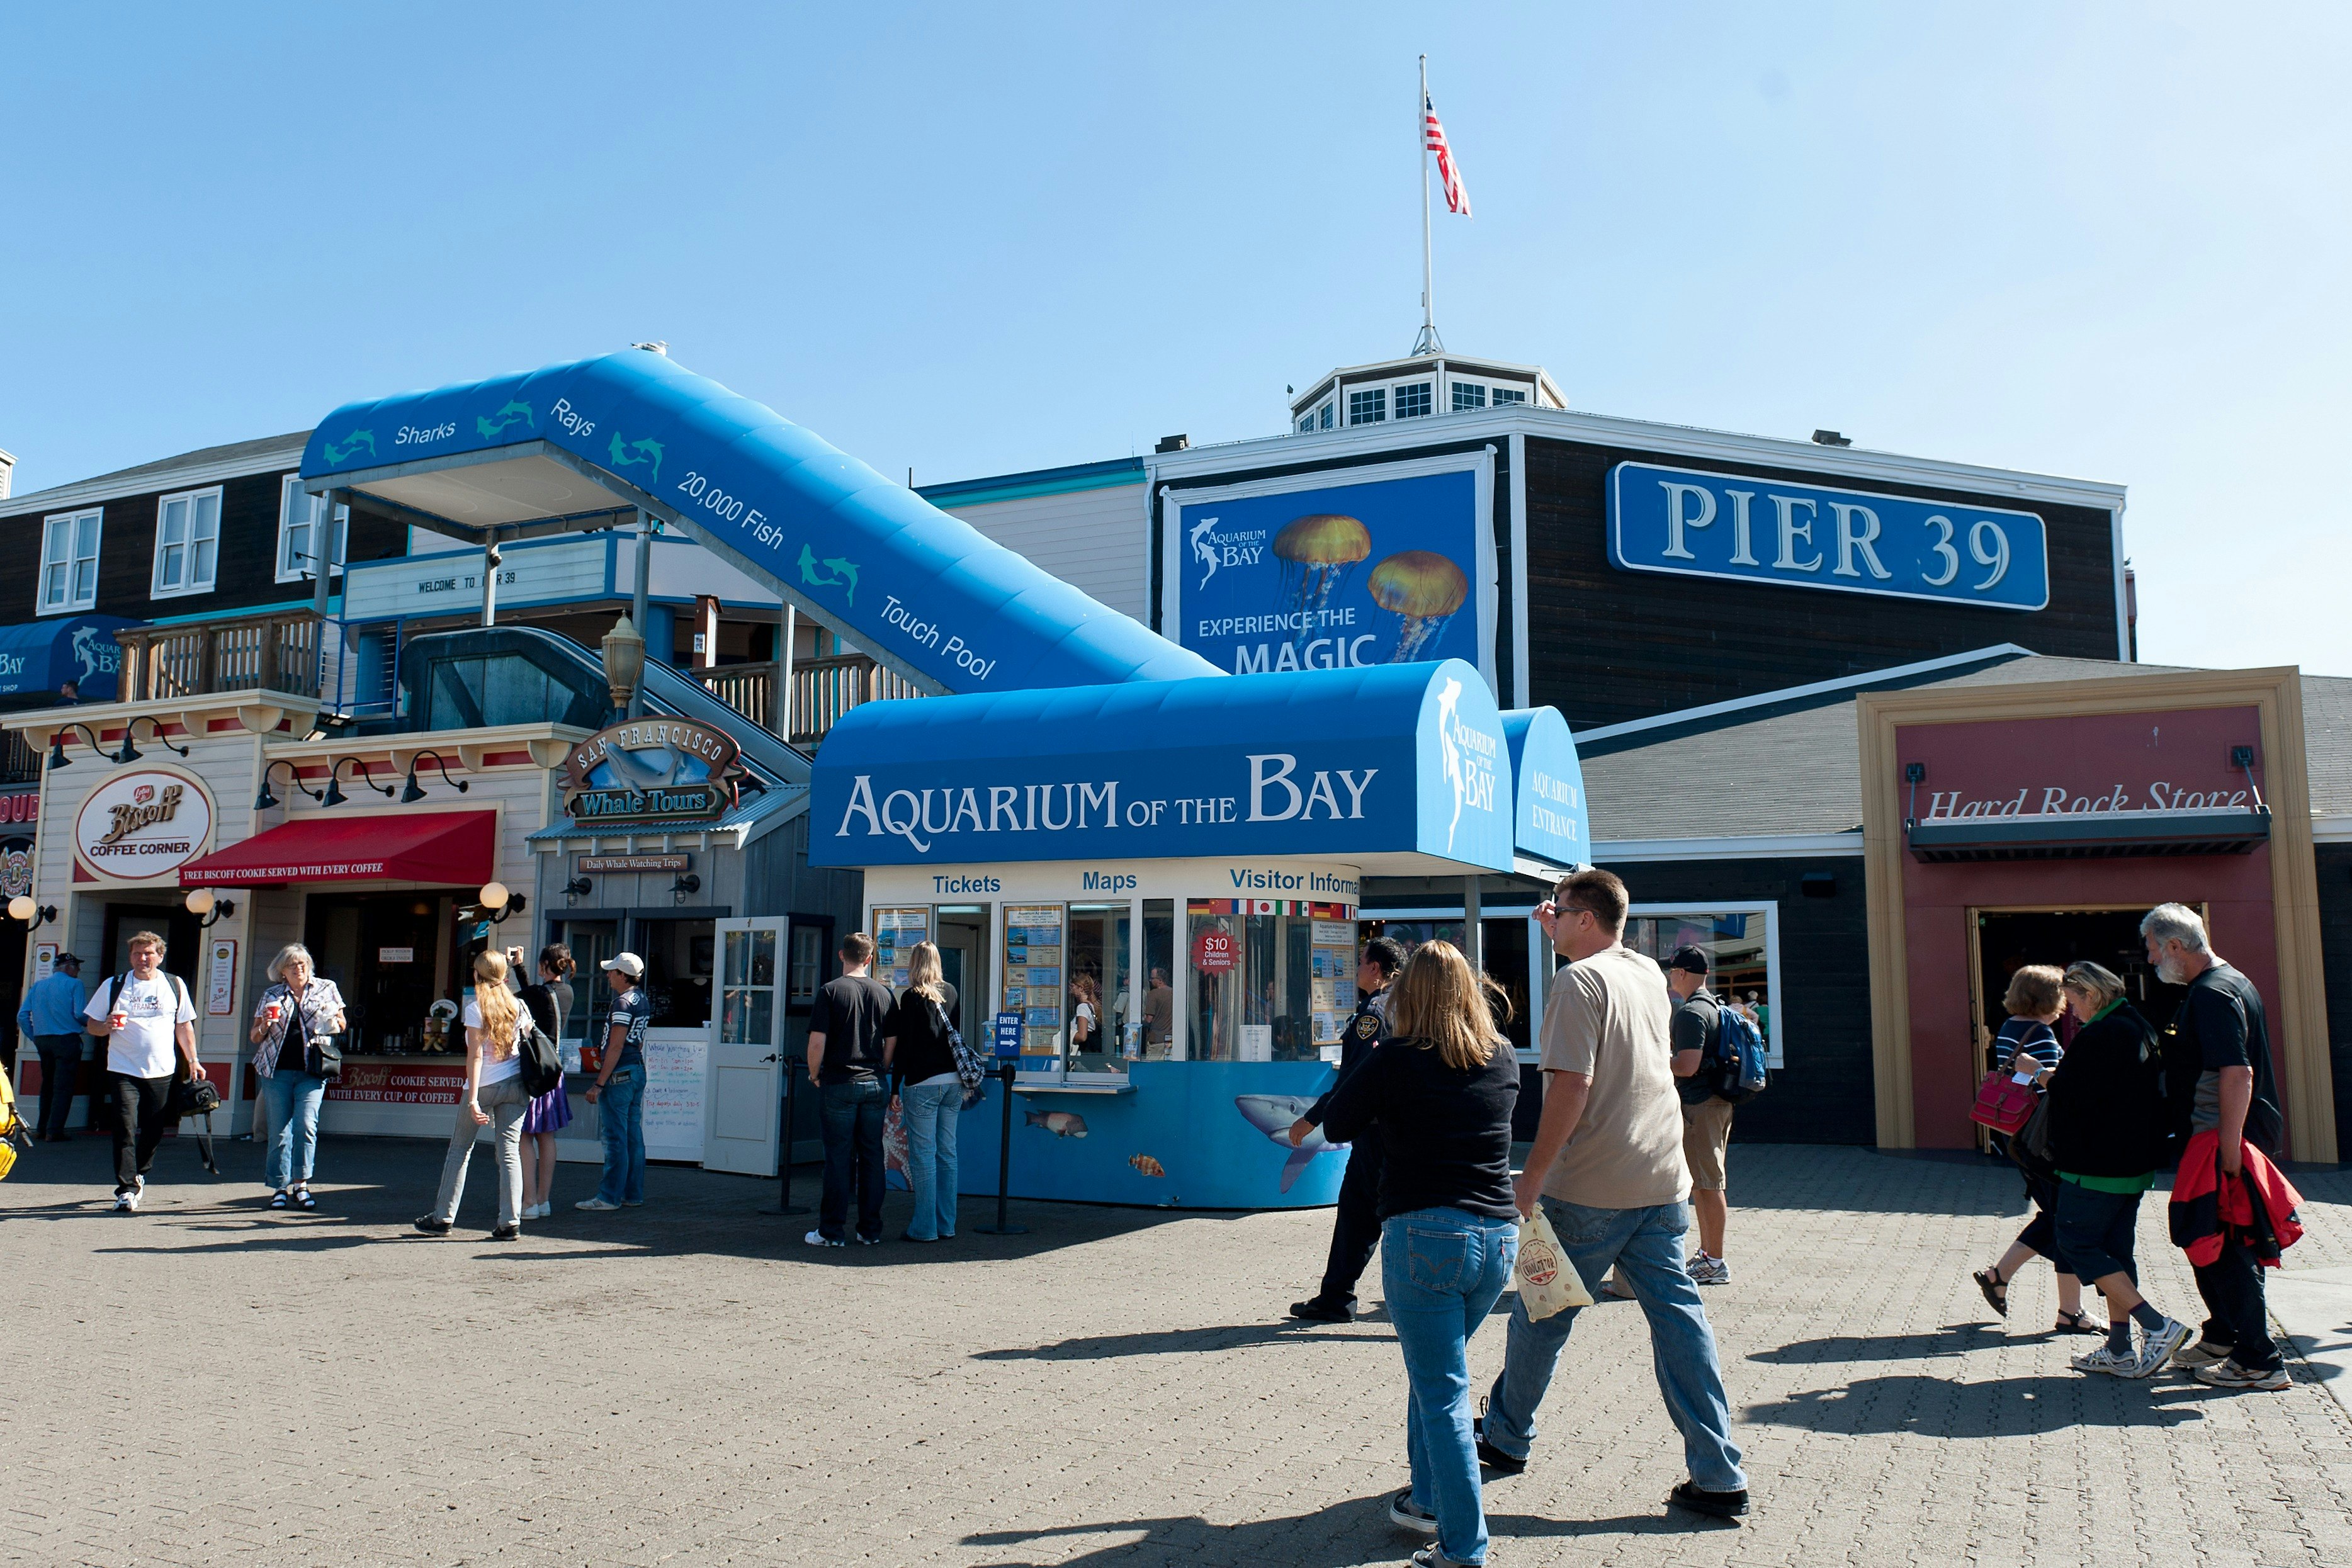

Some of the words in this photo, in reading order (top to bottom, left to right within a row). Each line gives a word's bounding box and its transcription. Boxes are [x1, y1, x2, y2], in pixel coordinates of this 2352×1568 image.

[550, 398, 596, 437] Rays
[395, 422, 456, 445] Sharks
[677, 470, 744, 522] 20,000
[741, 508, 784, 551] Fish
[1207, 529, 1266, 546] AQUARIUM
[1658, 480, 1892, 580] PIER
[1921, 514, 2011, 591] 39
[1223, 546, 1264, 567] BAY
[419, 578, 456, 594] WELCOME
[464, 577, 475, 589] TO
[504, 572, 516, 584] 39
[1199, 611, 1313, 638] EXPERIENCE
[1317, 607, 1356, 627] THE
[87, 639, 121, 655] AQUAR
[880, 595, 941, 649] Touch
[941, 635, 997, 682] Pool
[98, 655, 121, 674] BA
[1235, 634, 1377, 675] MAGIC
[577, 736, 608, 769] SAN
[618, 725, 723, 762] FRANCISCO
[1452, 714, 1496, 759] AQUARIUM
[1464, 759, 1496, 813] BAY
[1531, 769, 1578, 809] AQUARIUM
[0, 794, 40, 823] OUD
[99, 784, 183, 844] Biscoff
[580, 791, 645, 816] Whale
[647, 789, 707, 813] Tours
[835, 774, 1120, 853] AQUARIUM
[1126, 800, 1170, 828] OF
[1174, 797, 1238, 825] THE
[1245, 753, 1379, 822] BAY
[1925, 788, 2029, 821] Hard
[2039, 784, 2129, 819] Rock
[2142, 781, 2247, 816] Store
[1532, 803, 1577, 842] ENTRANCE
[90, 843, 137, 857] COFFEE
[139, 842, 190, 855] CORNER
[184, 870, 203, 880] FREE
[204, 869, 236, 879] BISCOFF
[236, 867, 267, 879] COOKIE
[267, 866, 298, 877] SERVED
[299, 866, 321, 876] WITH
[322, 864, 349, 875] EVERY
[351, 862, 383, 874] COFFEE
[586, 860, 604, 871] Daily
[606, 859, 628, 869] Whale
[629, 859, 662, 869] Watching
[663, 858, 681, 868] Trips
[933, 875, 1001, 894] Tickets
[1083, 871, 1138, 894] Maps
[1230, 869, 1304, 890] Visitor
[1310, 871, 1360, 895] Informa
[1205, 937, 1228, 952] $10
[999, 1016, 1019, 1025] ENTER
[1000, 1027, 1016, 1035] HERE
[327, 1074, 342, 1083] EE
[341, 1066, 392, 1089] Biscoff
[391, 1075, 426, 1086] COOKIE
[428, 1076, 463, 1087] SERVED
[329, 1090, 352, 1100] WITH
[354, 1090, 382, 1100] EVERY
[384, 1091, 403, 1102] CUP
[405, 1092, 417, 1102] OF
[419, 1093, 455, 1103] COFFEE
